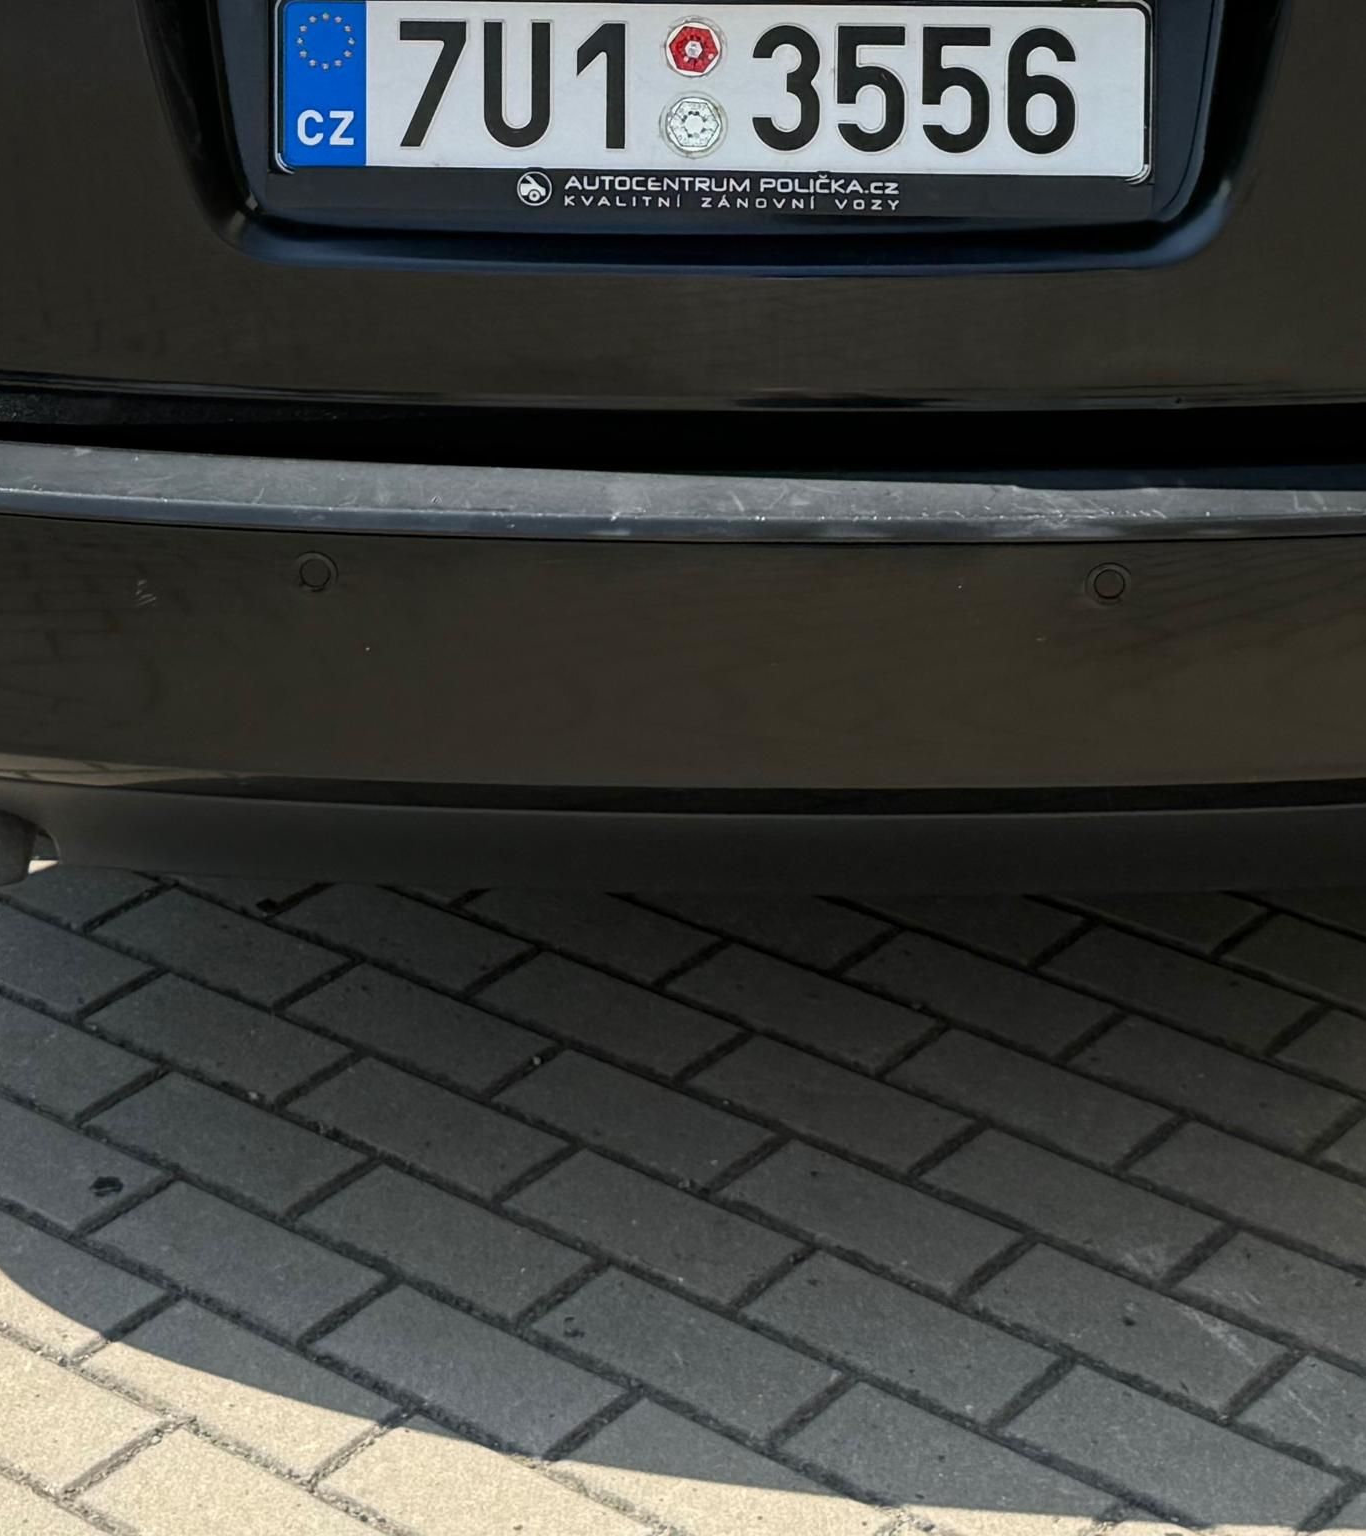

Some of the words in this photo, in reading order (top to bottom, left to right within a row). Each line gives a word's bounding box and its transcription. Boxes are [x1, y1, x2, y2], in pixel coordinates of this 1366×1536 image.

[397, 18, 629, 151] 7U1
[751, 24, 1077, 156] 3556
[295, 109, 356, 147] CZ
[564, 175, 751, 193] AUTOCENTRUM
[563, 193, 682, 209] KVALITNÍ
[701, 195, 815, 210] ZÁNOVNÍ
[834, 199, 900, 211] VOZY
